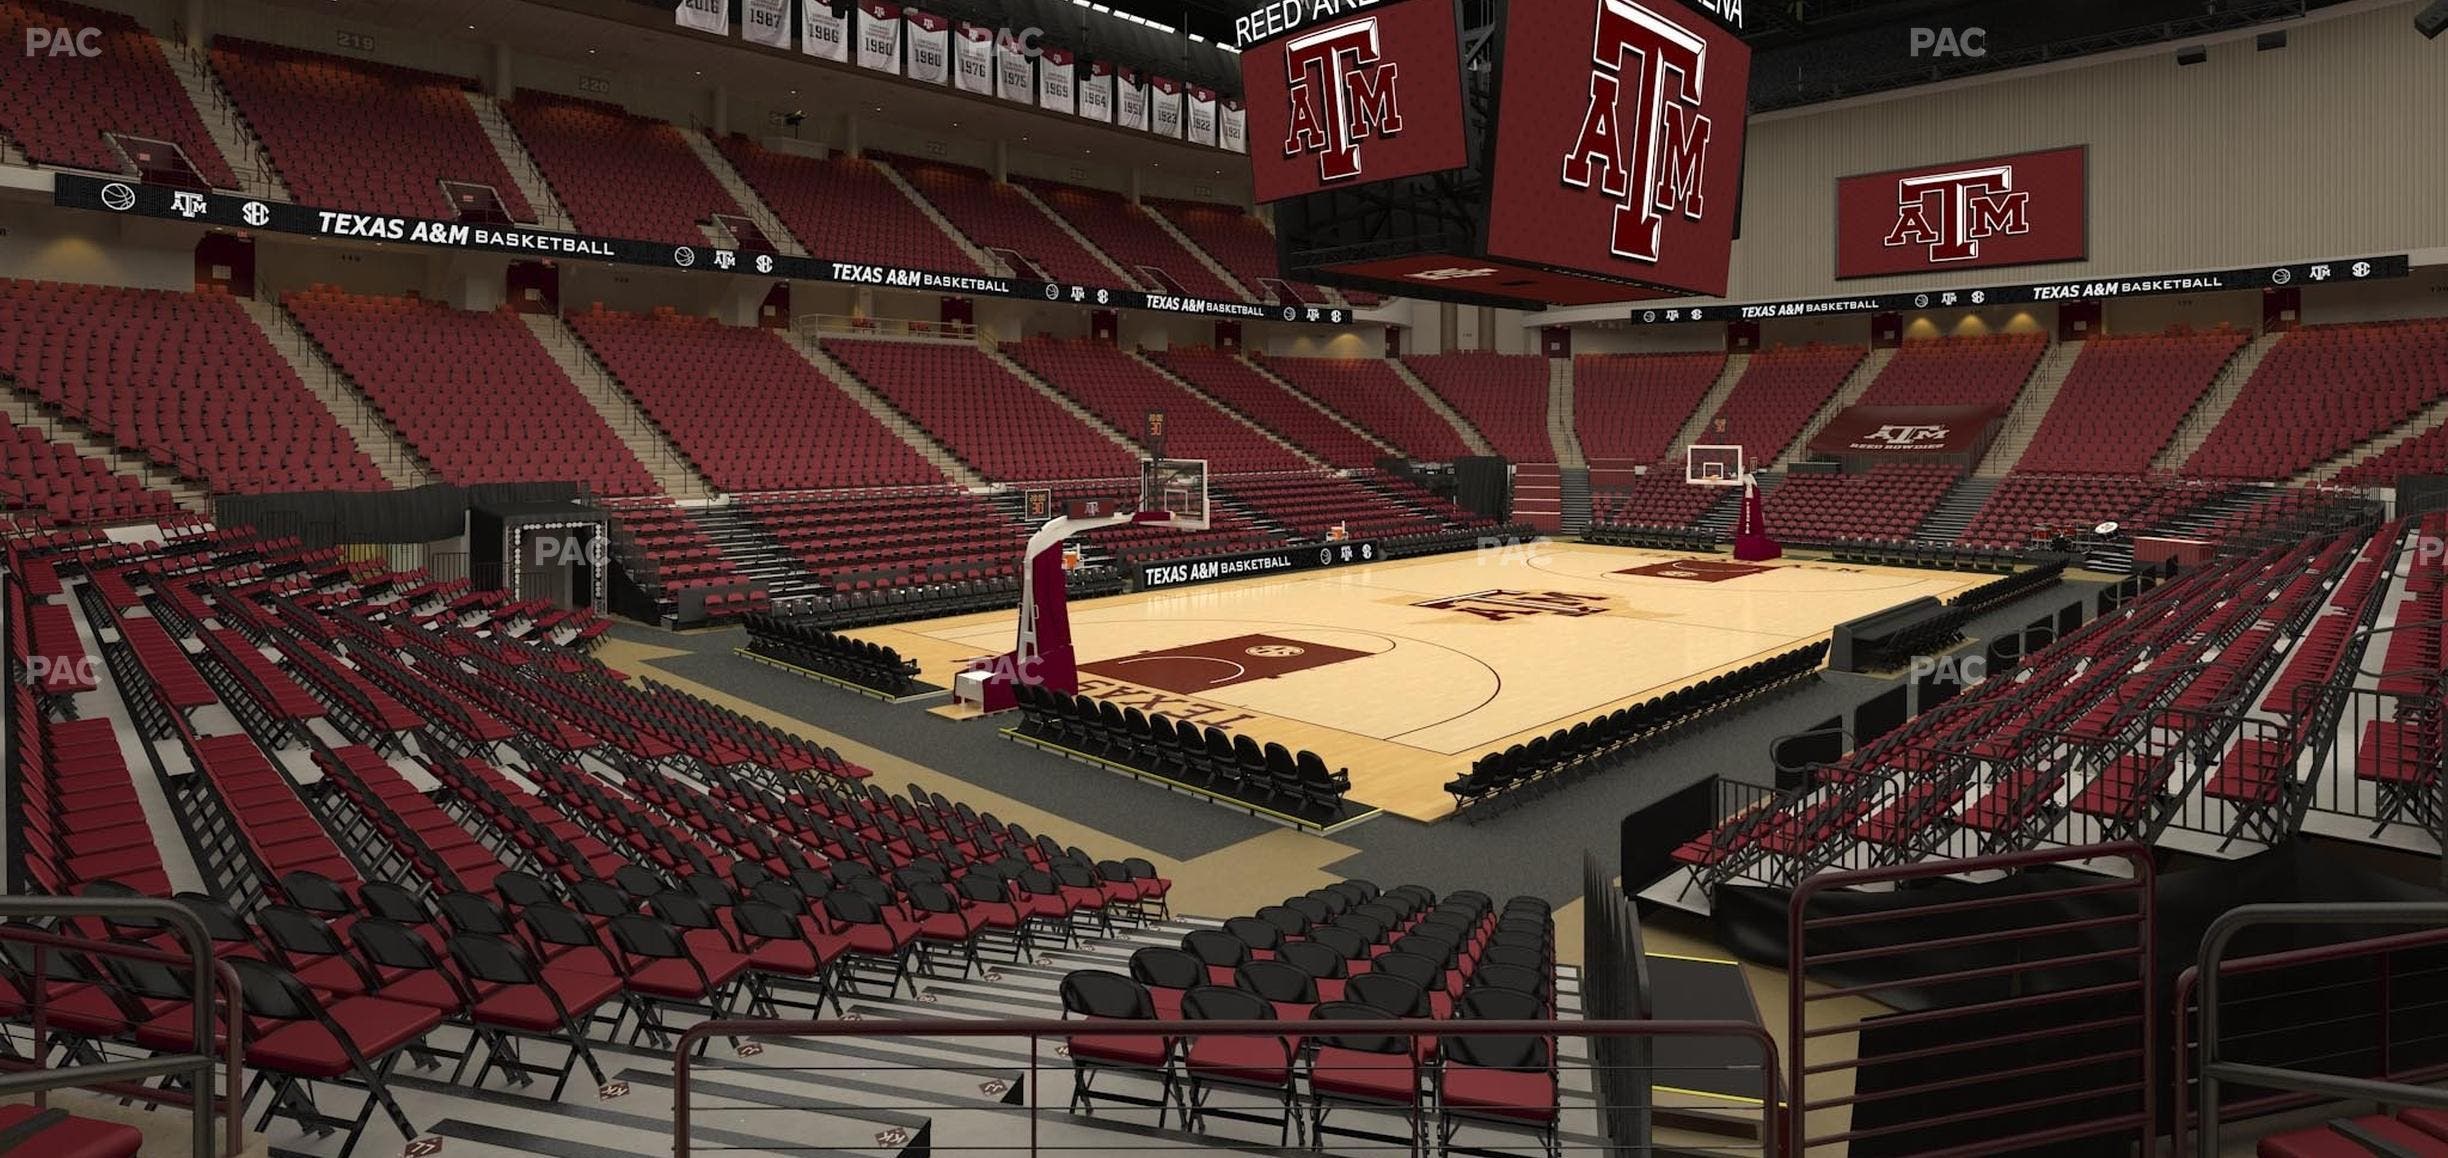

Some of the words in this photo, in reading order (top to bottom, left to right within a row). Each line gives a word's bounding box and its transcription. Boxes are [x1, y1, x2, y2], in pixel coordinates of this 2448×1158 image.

[750, 8, 782, 28] 1987
[1235, 0, 1302, 47] REED
[337, 32, 374, 50] 219
[808, 22, 840, 44] 1986
[864, 37, 893, 57] 1980
[914, 48, 942, 68] 1980
[960, 58, 986, 78] 1976
[1003, 70, 1028, 88] 1975
[242, 201, 270, 226] SEC
[318, 211, 405, 240] TEXAS
[410, 221, 470, 246] A&M
[475, 229, 615, 256] BASKETBALL
[832, 263, 884, 284] TEXAS
[885, 270, 922, 287] A&M
[924, 274, 1010, 293] BASKETBALL
[2032, 285, 2080, 300] TEXAS
[2083, 281, 2119, 297] A&M
[2121, 276, 2223, 293] BASKETBALL
[1146, 295, 1181, 312] TEXAS
[1181, 299, 1206, 314] A&M
[1207, 303, 1265, 318] BASKETBALL
[1741, 305, 1777, 319] TEXAS
[1778, 303, 1804, 317] A&M
[1806, 300, 1880, 313] BASKETBALL
[1146, 565, 1187, 586] TEXAS
[1190, 561, 1219, 581] A&M
[1220, 555, 1292, 574] BASKETBALL
